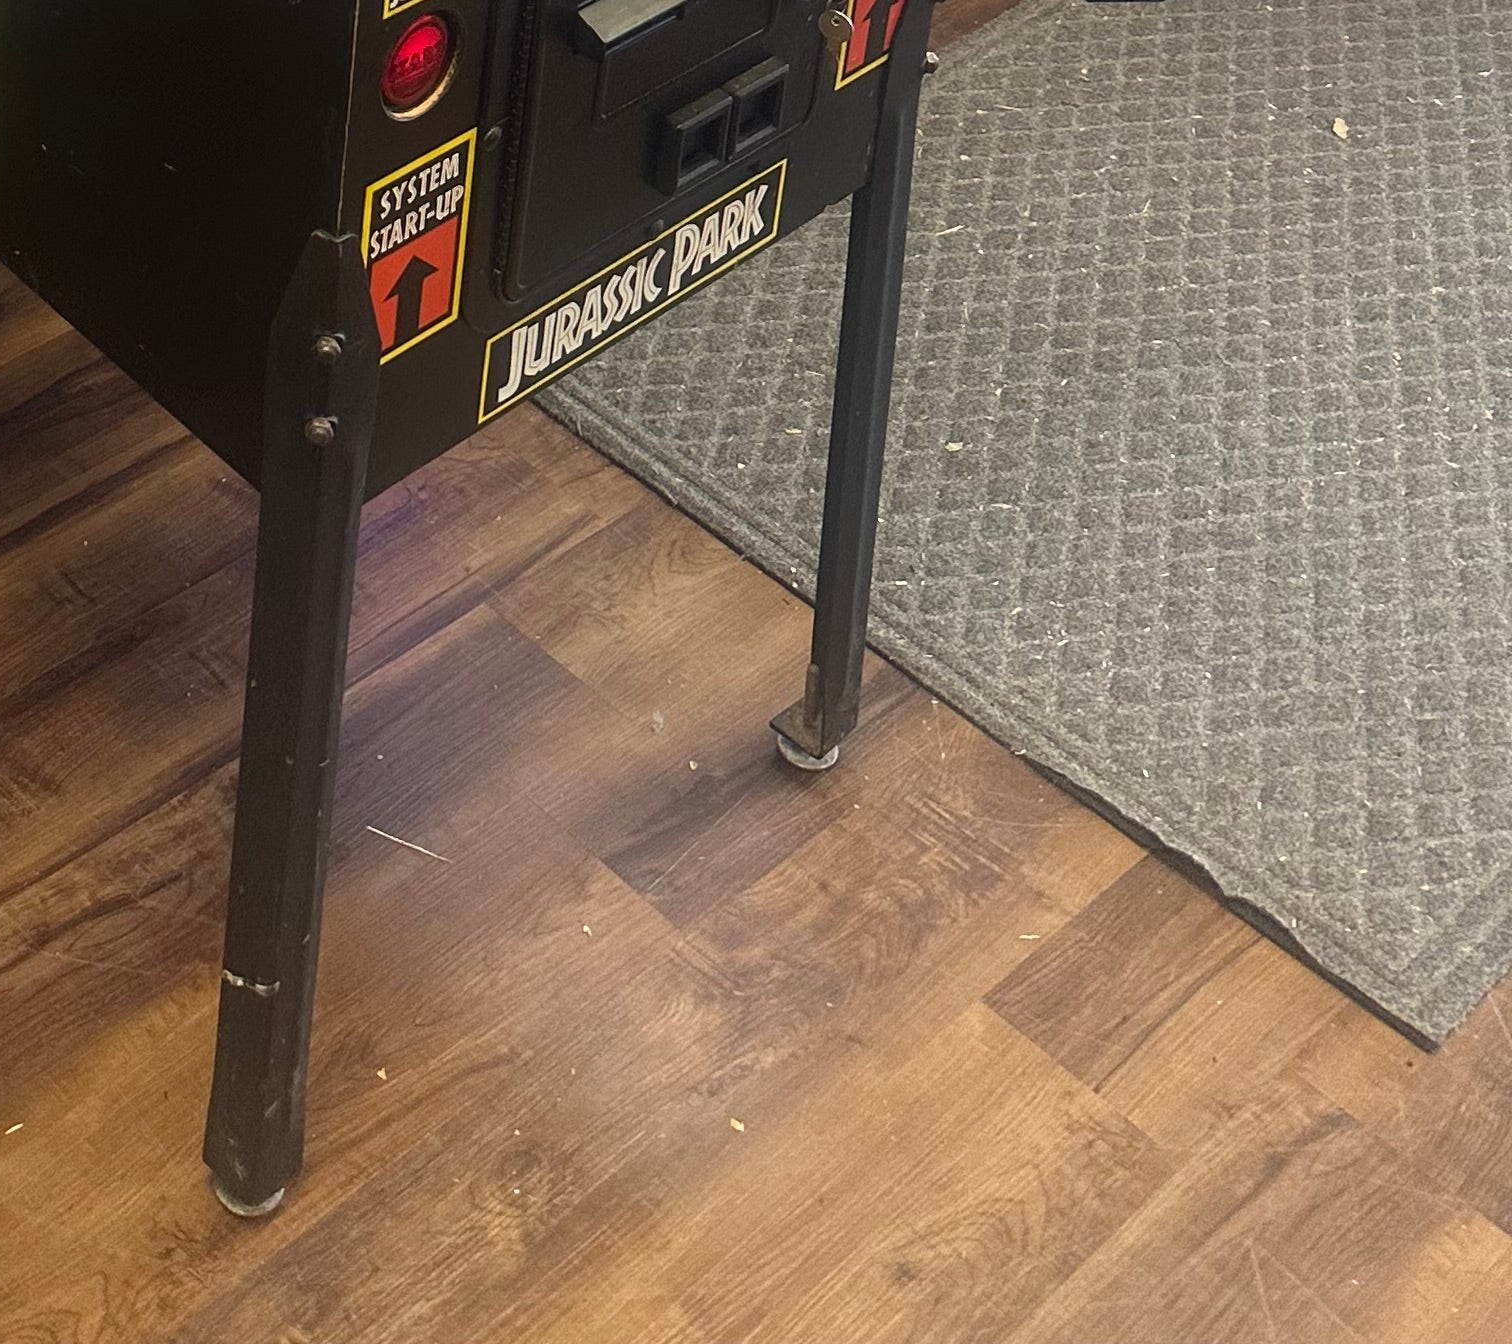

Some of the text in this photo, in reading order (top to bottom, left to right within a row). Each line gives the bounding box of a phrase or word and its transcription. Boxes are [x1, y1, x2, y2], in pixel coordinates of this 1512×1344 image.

[370, 184, 465, 259] START-UP
[379, 152, 461, 220] SYSTEM
[497, 184, 769, 403] JURASSIC PARK
